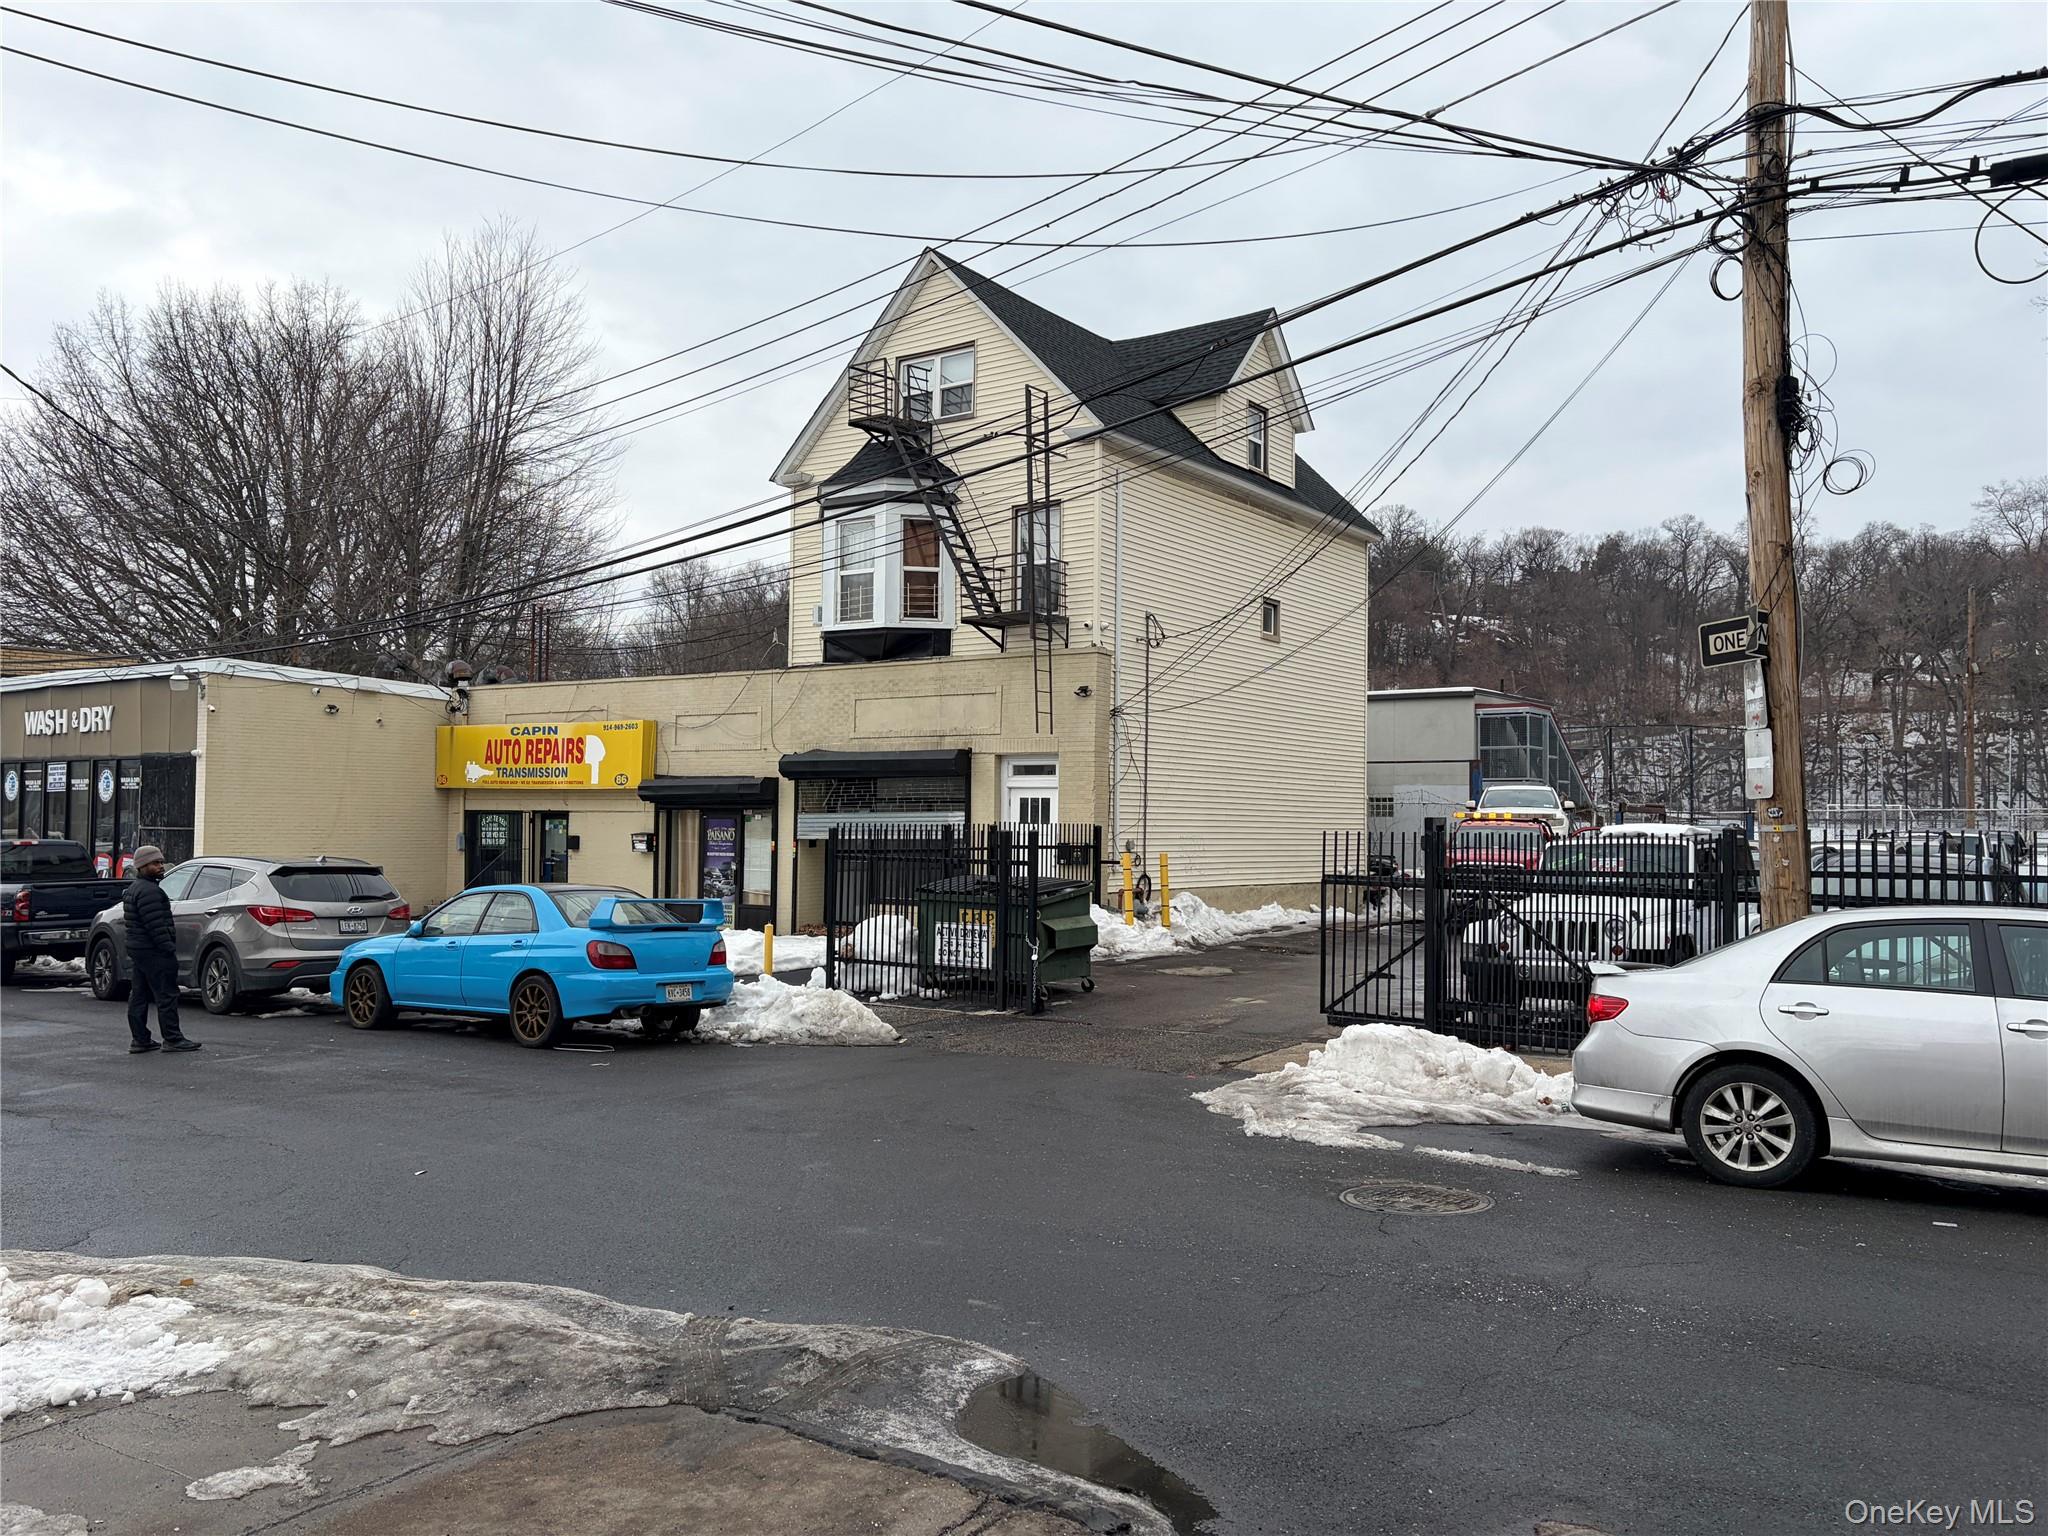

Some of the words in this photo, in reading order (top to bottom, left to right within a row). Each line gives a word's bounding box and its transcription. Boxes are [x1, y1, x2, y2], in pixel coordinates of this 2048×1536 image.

[1713, 631, 1746, 652] ONE
[24, 709, 68, 735] WASH
[71, 711, 79, 729] &
[79, 705, 114, 733] DRY
[510, 726, 558, 736] CAPIN
[484, 738, 522, 765] AUTO
[525, 736, 585, 765] REPAIRS
[496, 767, 568, 778] TRANSMISSION
[706, 828, 736, 841] PAISANO
[936, 926, 959, 937] ATV
